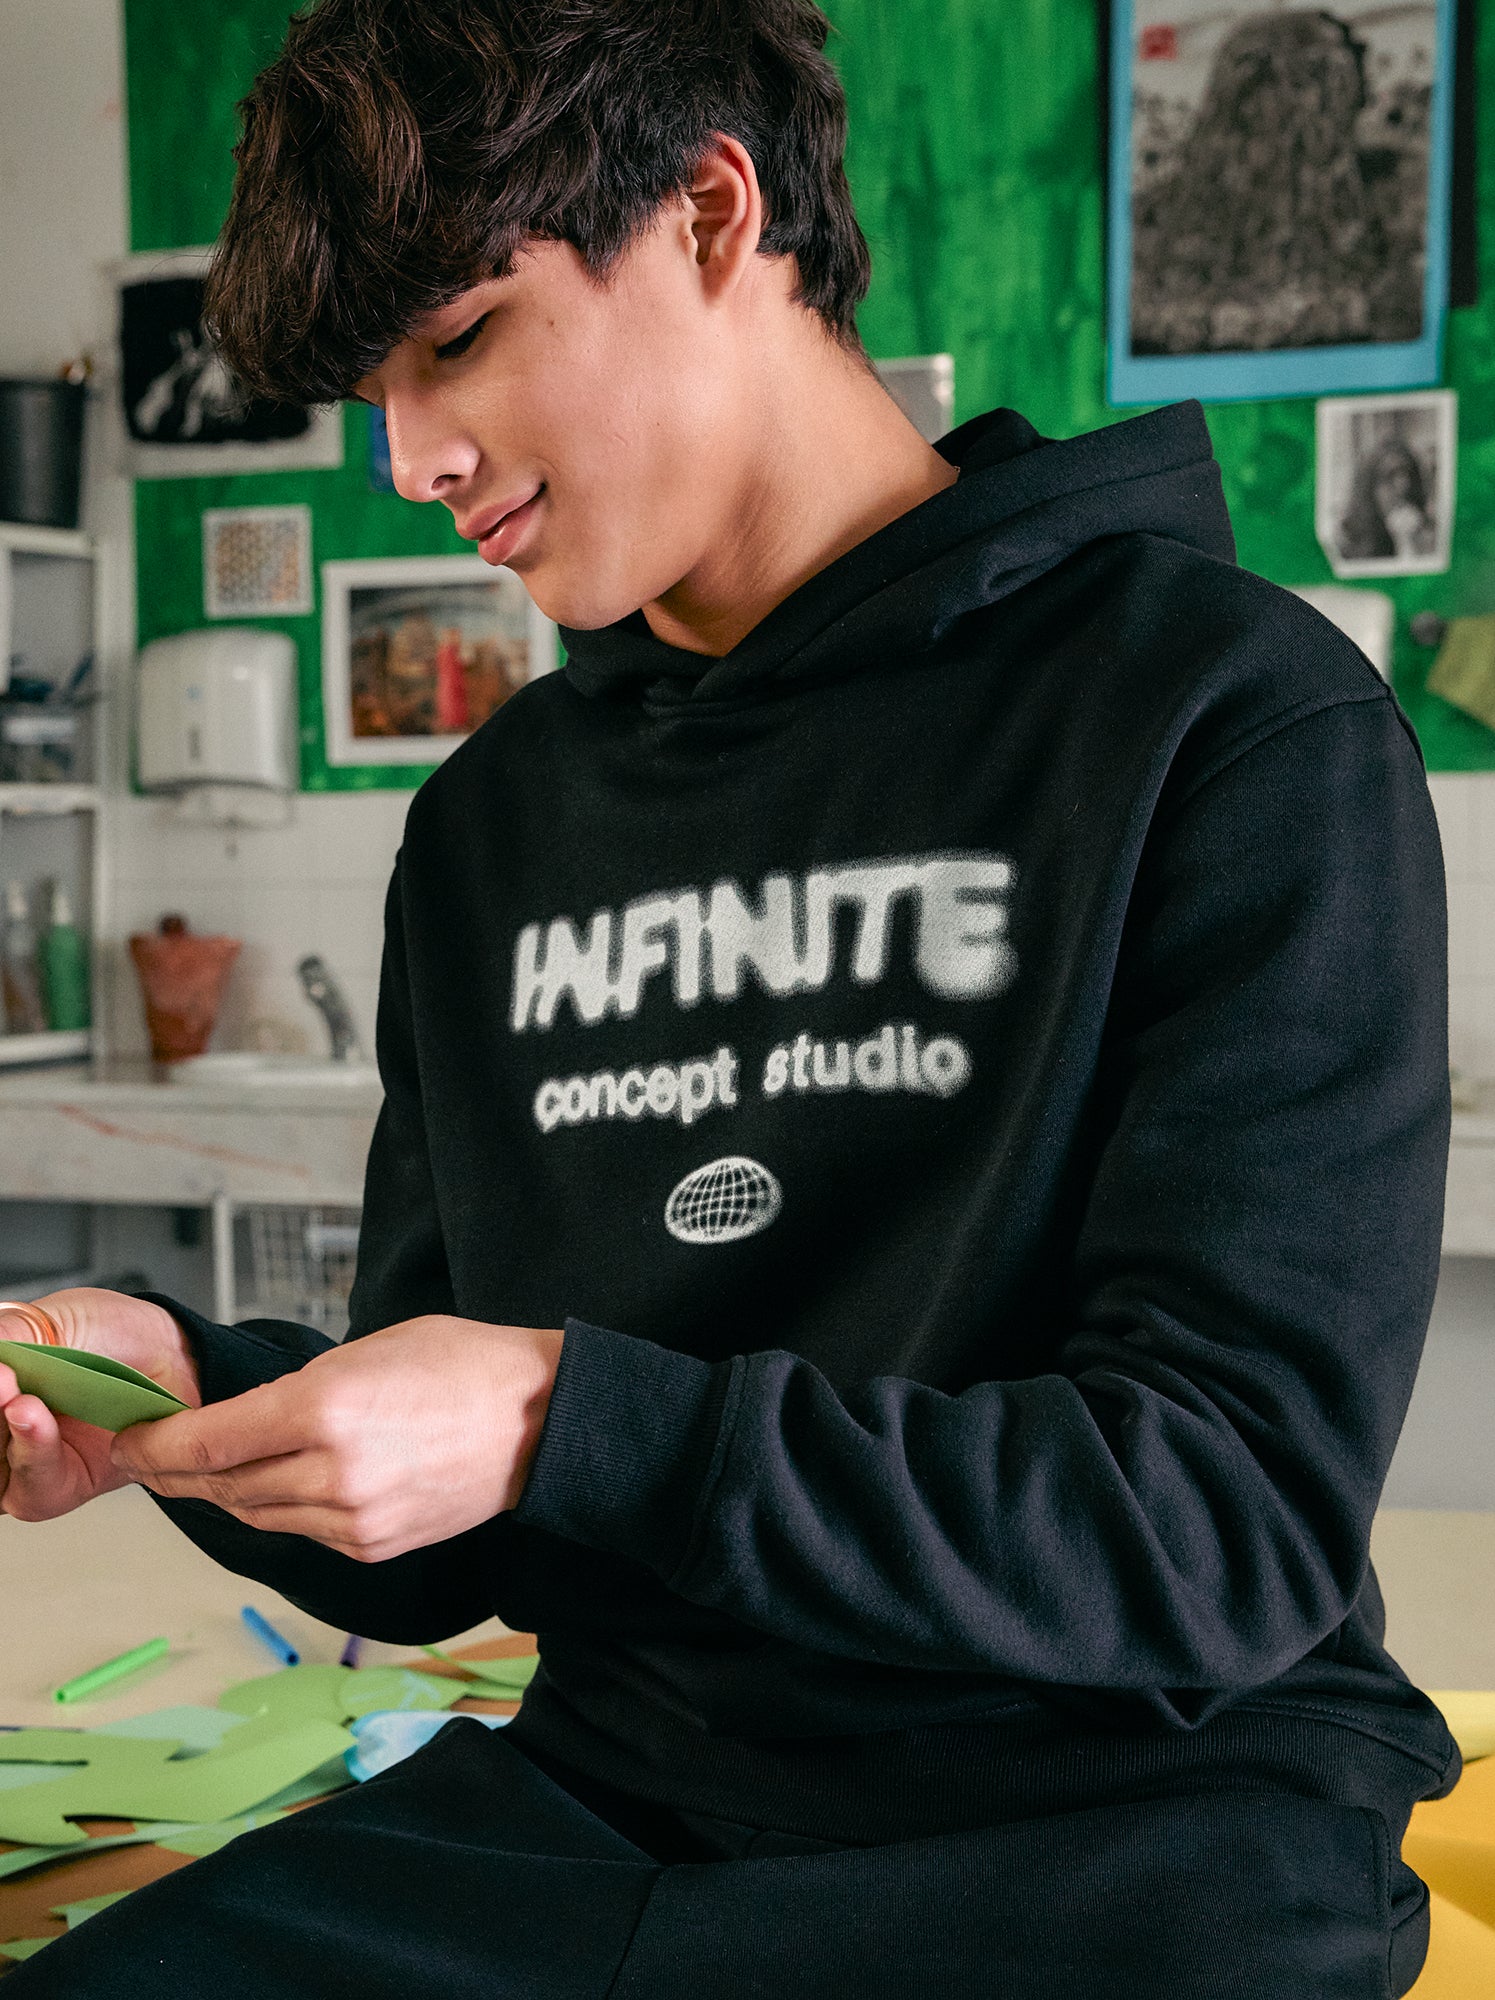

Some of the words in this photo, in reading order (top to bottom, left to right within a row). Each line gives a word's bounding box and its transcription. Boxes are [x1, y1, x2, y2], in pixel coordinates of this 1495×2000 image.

[510, 853, 1015, 1031] INFINITE
[534, 1046, 738, 1132] concept
[763, 1023, 971, 1097] studio
